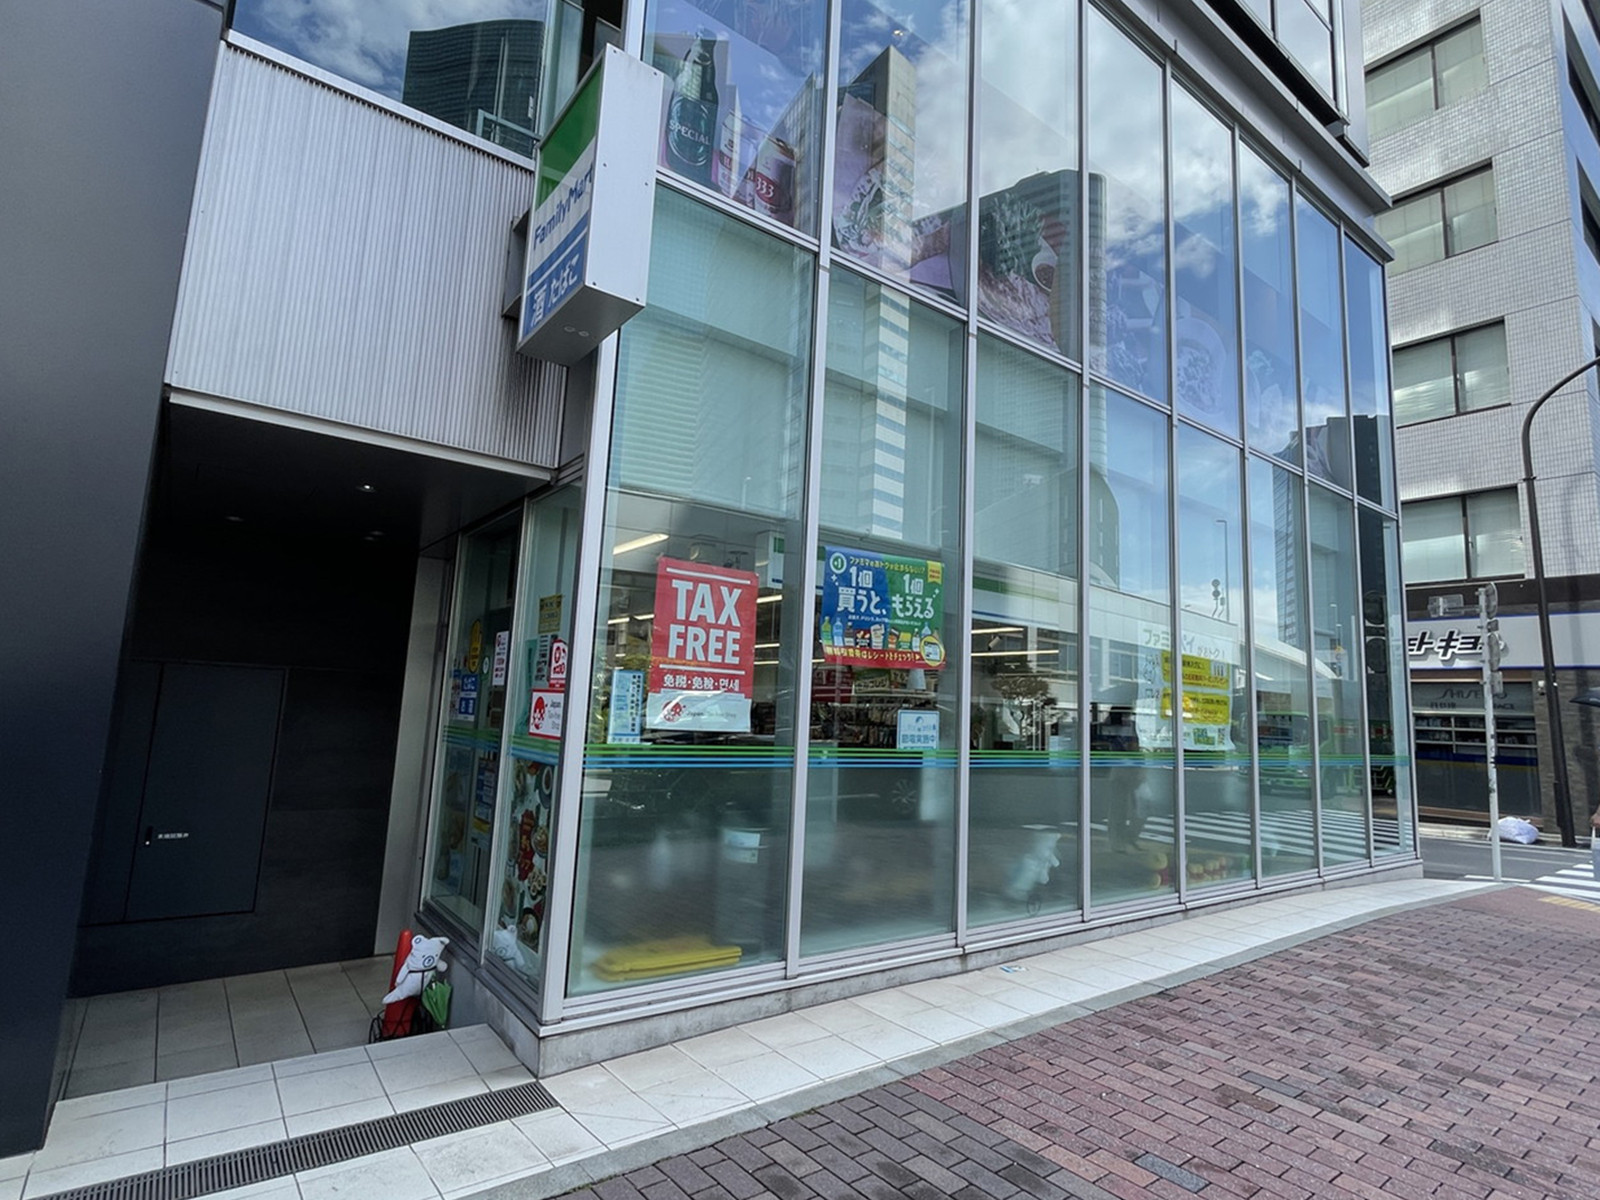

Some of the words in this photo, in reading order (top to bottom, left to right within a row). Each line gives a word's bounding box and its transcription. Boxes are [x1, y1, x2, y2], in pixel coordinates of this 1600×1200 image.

[668, 120, 711, 146] SPECIAL
[534, 162, 593, 251] FamilyMart
[548, 252, 581, 308] たばこ
[671, 578, 743, 627] TAX
[837, 586, 887, 615] 買うと、
[891, 593, 935, 619] もらえる
[667, 623, 741, 665] FREE
